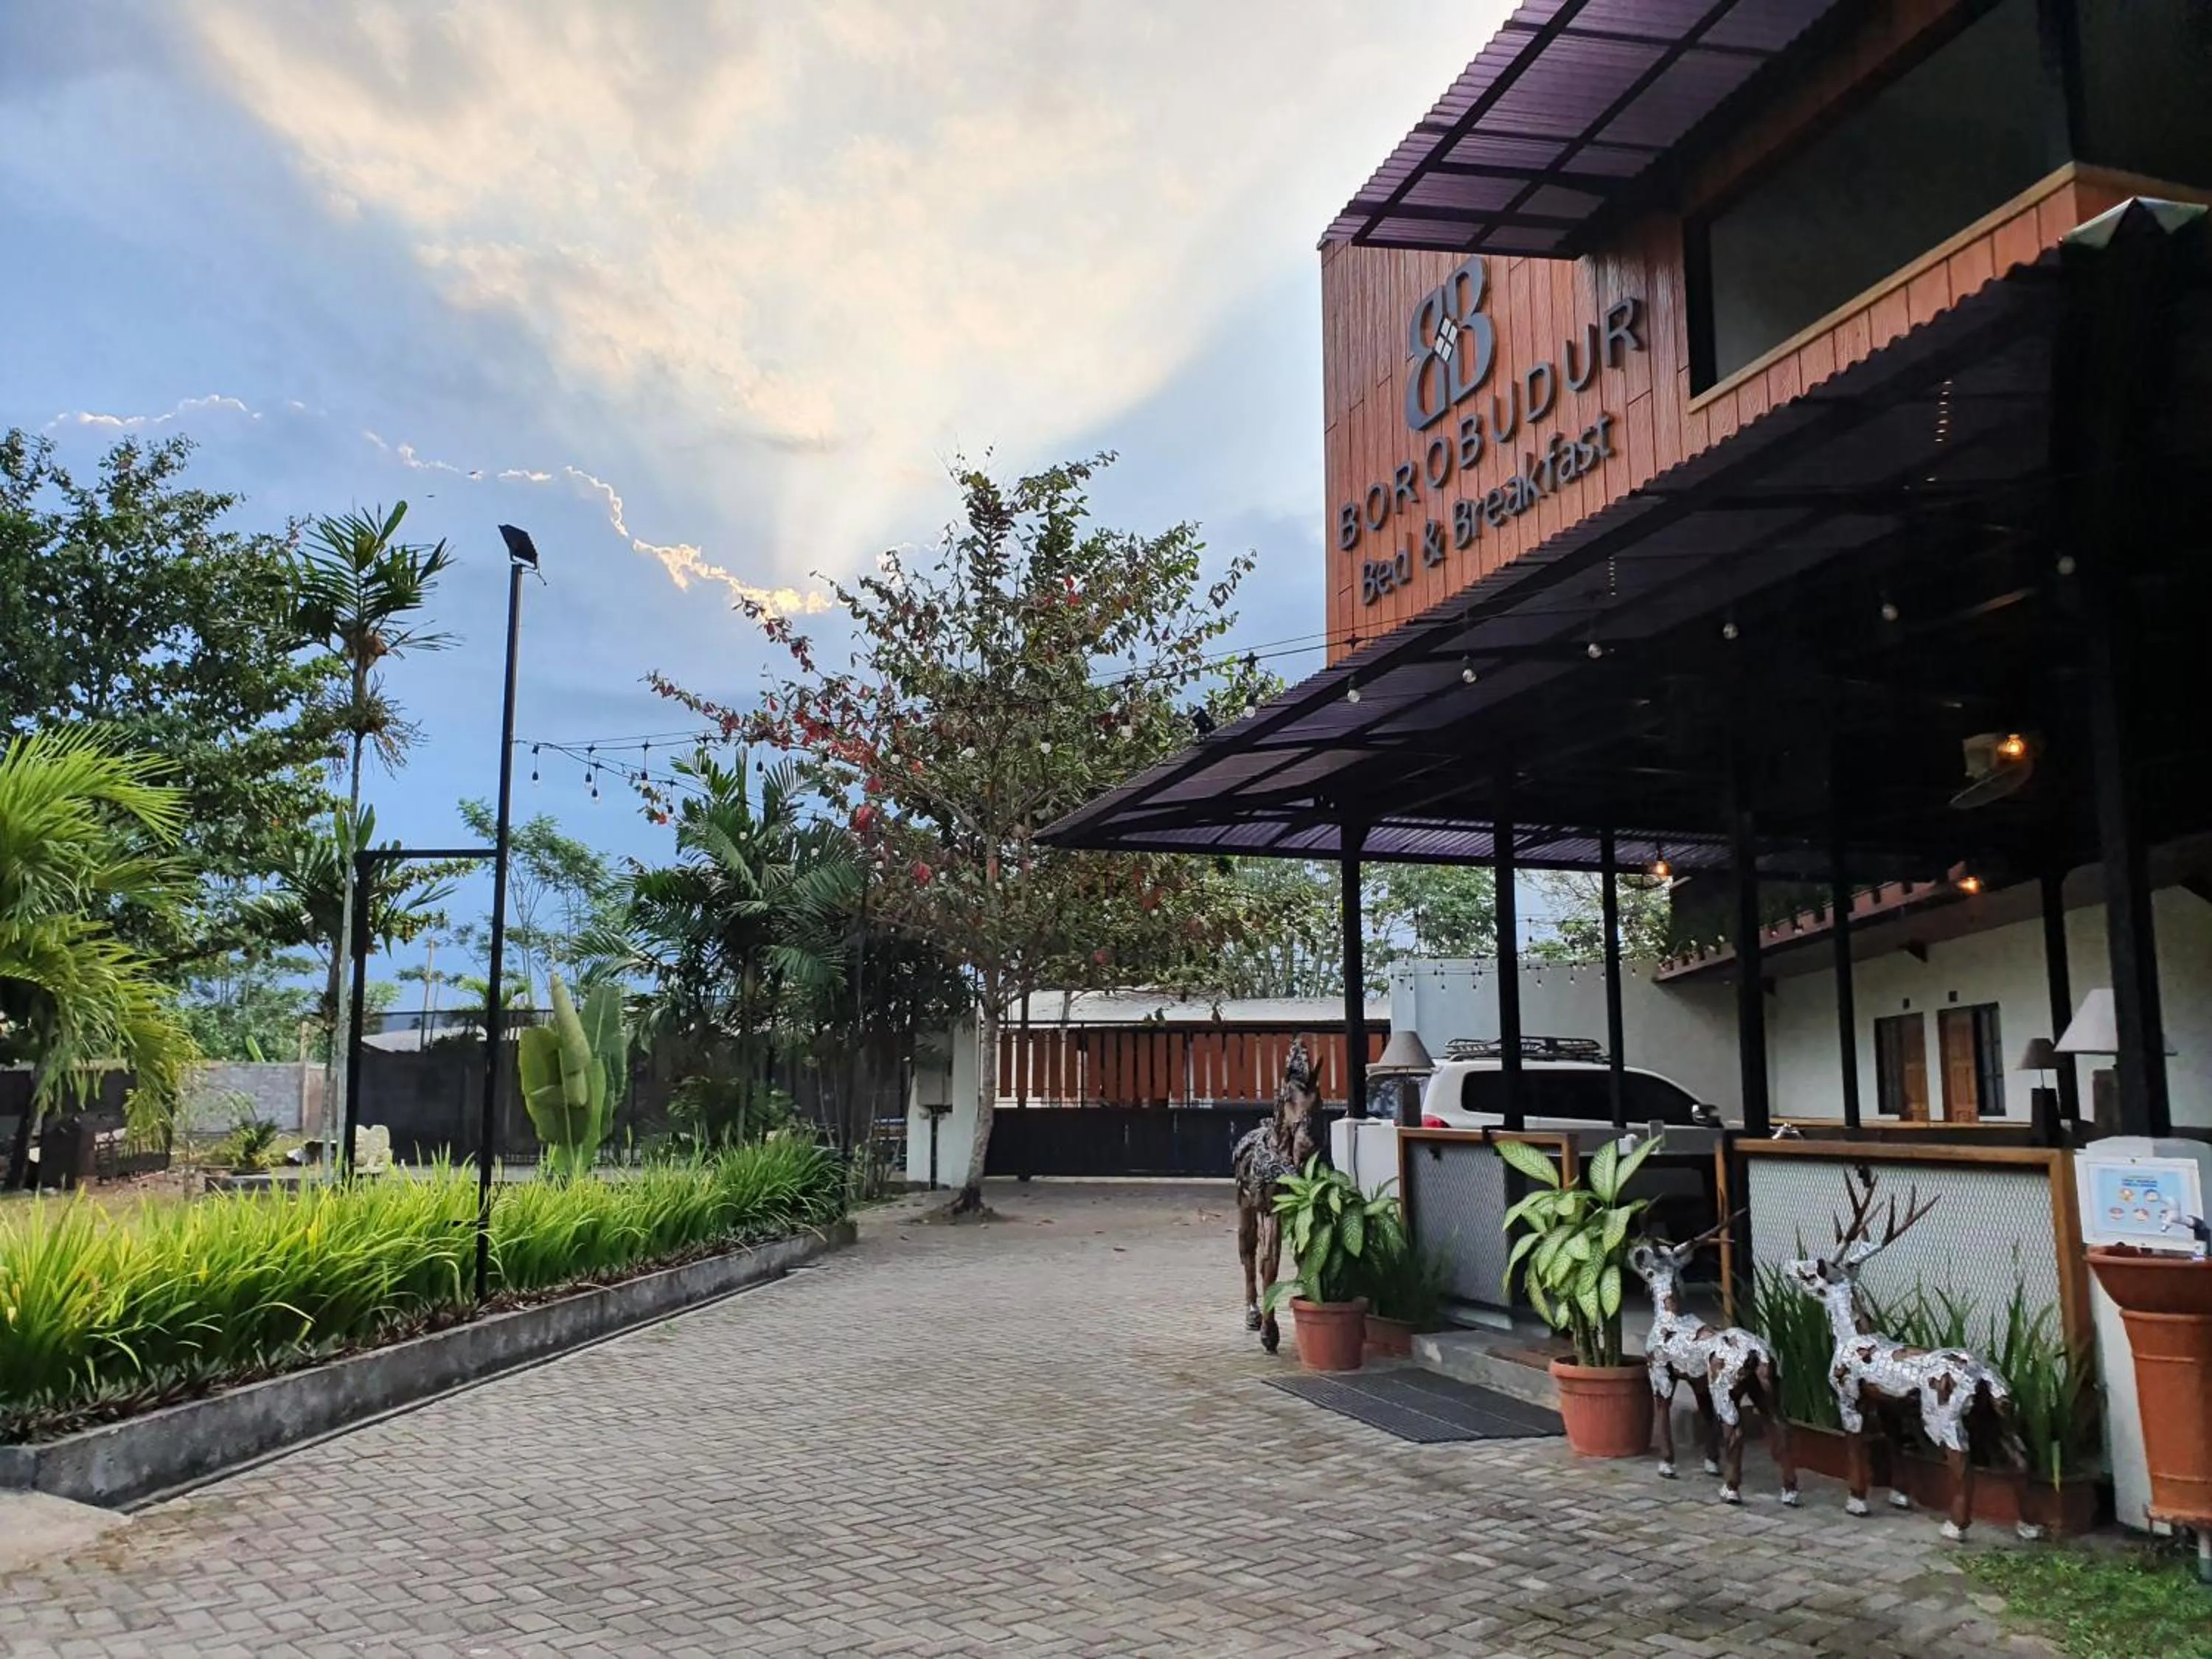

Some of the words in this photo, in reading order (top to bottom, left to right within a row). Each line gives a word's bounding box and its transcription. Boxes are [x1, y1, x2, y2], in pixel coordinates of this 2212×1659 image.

[1338, 296, 1647, 551] BOROBUDUR
[1362, 532, 1412, 606] Bed
[1423, 518, 1446, 567] &
[1452, 411, 1615, 549] Breakfast
